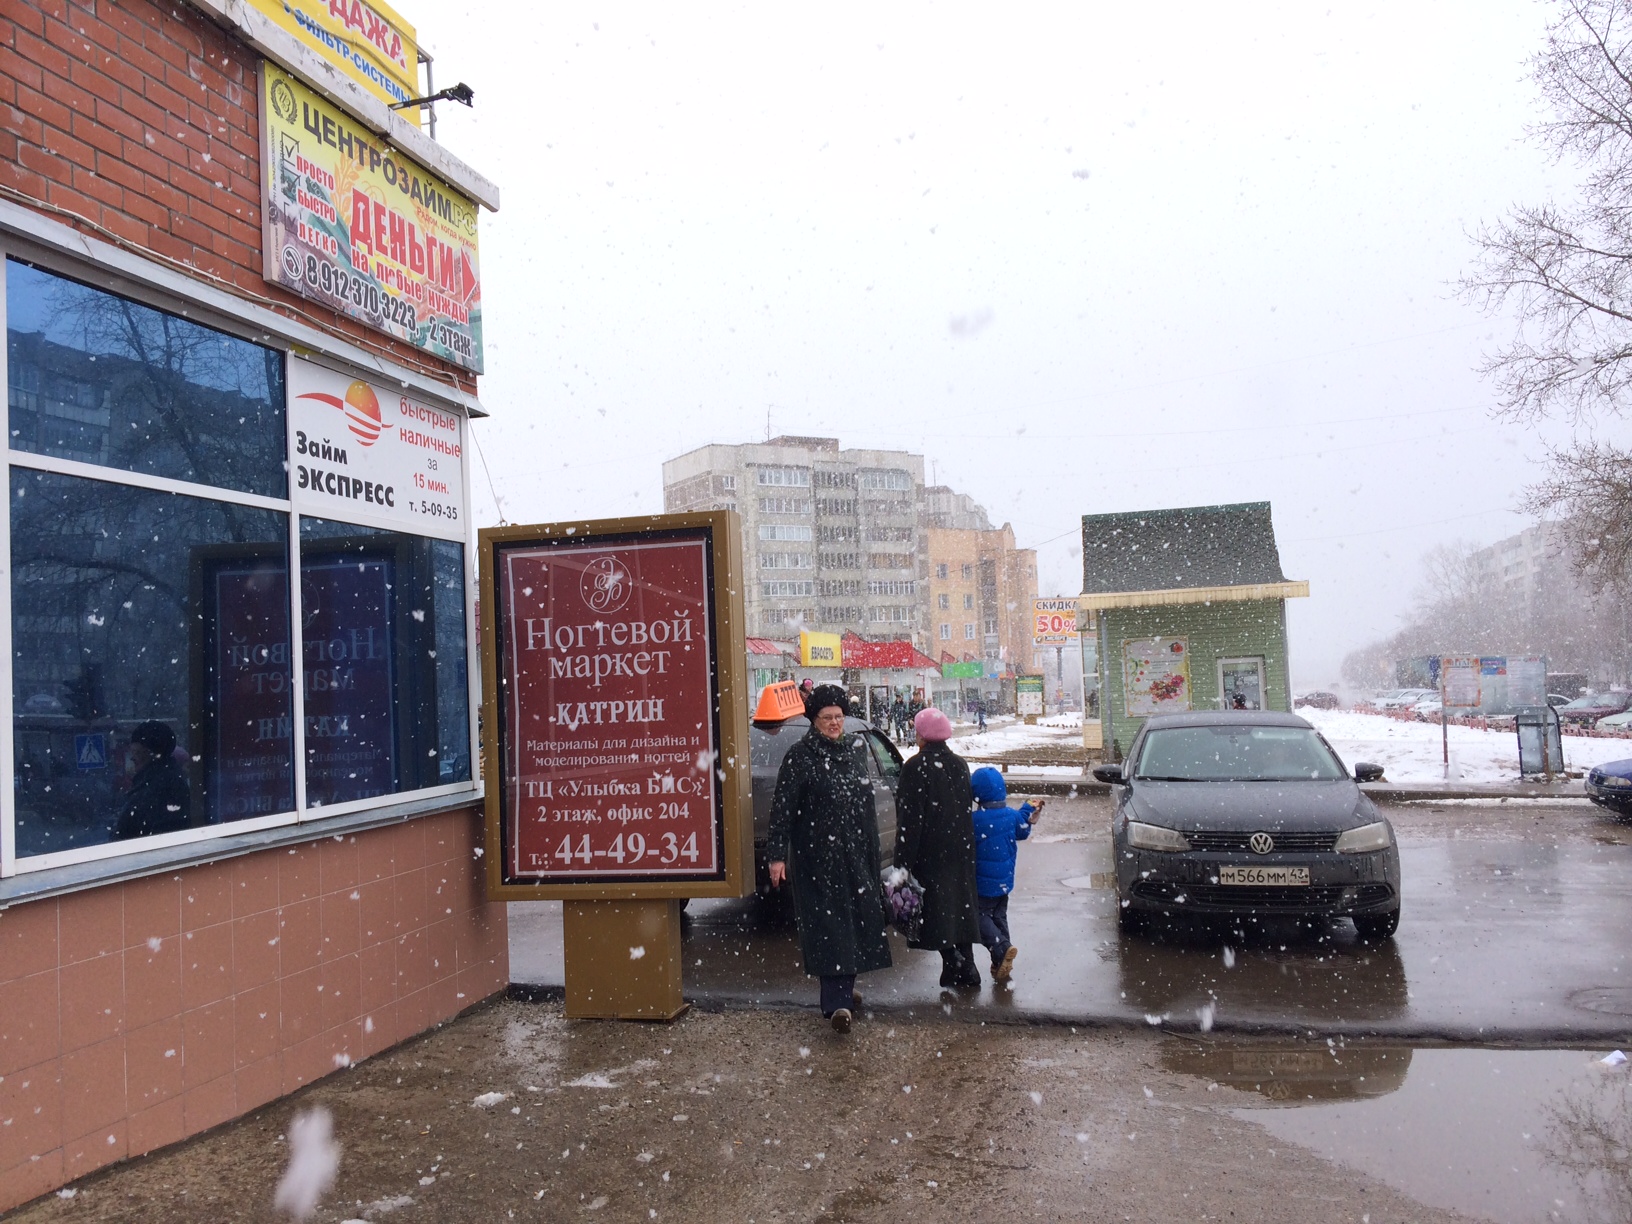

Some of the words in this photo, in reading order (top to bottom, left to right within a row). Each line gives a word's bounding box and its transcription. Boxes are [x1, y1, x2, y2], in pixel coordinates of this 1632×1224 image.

[317, 0, 406, 69] ДАЖА
[294, 9, 412, 108] ФИЛЬТР-СИСТЕМЫ
[296, 155, 334, 190] ПРОСТО
[297, 188, 336, 223] БЫСТРО
[350, 187, 455, 294] ДЕНЬГИ
[352, 248, 369, 275] на
[376, 261, 423, 300] любые
[428, 287, 469, 325] нужды
[307, 255, 317, 287] 8
[321, 262, 349, 300] 912
[351, 277, 379, 314] 370
[429, 315, 438, 342] 2
[440, 325, 472, 358] этаж
[400, 397, 455, 431] быстрые
[296, 431, 348, 465] Займ
[400, 427, 461, 458] наличные
[427, 458, 438, 471] за
[297, 465, 394, 508] ЭКСПРЕСС
[413, 472, 425, 489] 15
[427, 479, 450, 495] мин.
[409, 501, 418, 512] т.
[421, 500, 458, 520] 5-09-35
[524, 609, 693, 650] Ногтевой
[1036, 615, 1077, 633] 50%
[548, 650, 671, 687] маркет
[556, 699, 665, 727] КАТРИН
[774, 684, 800, 708] 7-7777
[527, 738, 599, 752] Материалы
[602, 737, 627, 750] для
[631, 734, 686, 748] дизайна
[691, 735, 700, 746] и
[535, 753, 640, 768] моделирования
[644, 751, 691, 765] ногтей
[525, 781, 553, 800] ТЦ
[558, 779, 641, 798] «Улыбка
[647, 775, 704, 795] БИС»
[538, 806, 548, 822] 2
[552, 807, 602, 824] этаж,
[607, 804, 653, 825] офис
[658, 802, 690, 820] 204
[555, 831, 699, 865] 44-49-34
